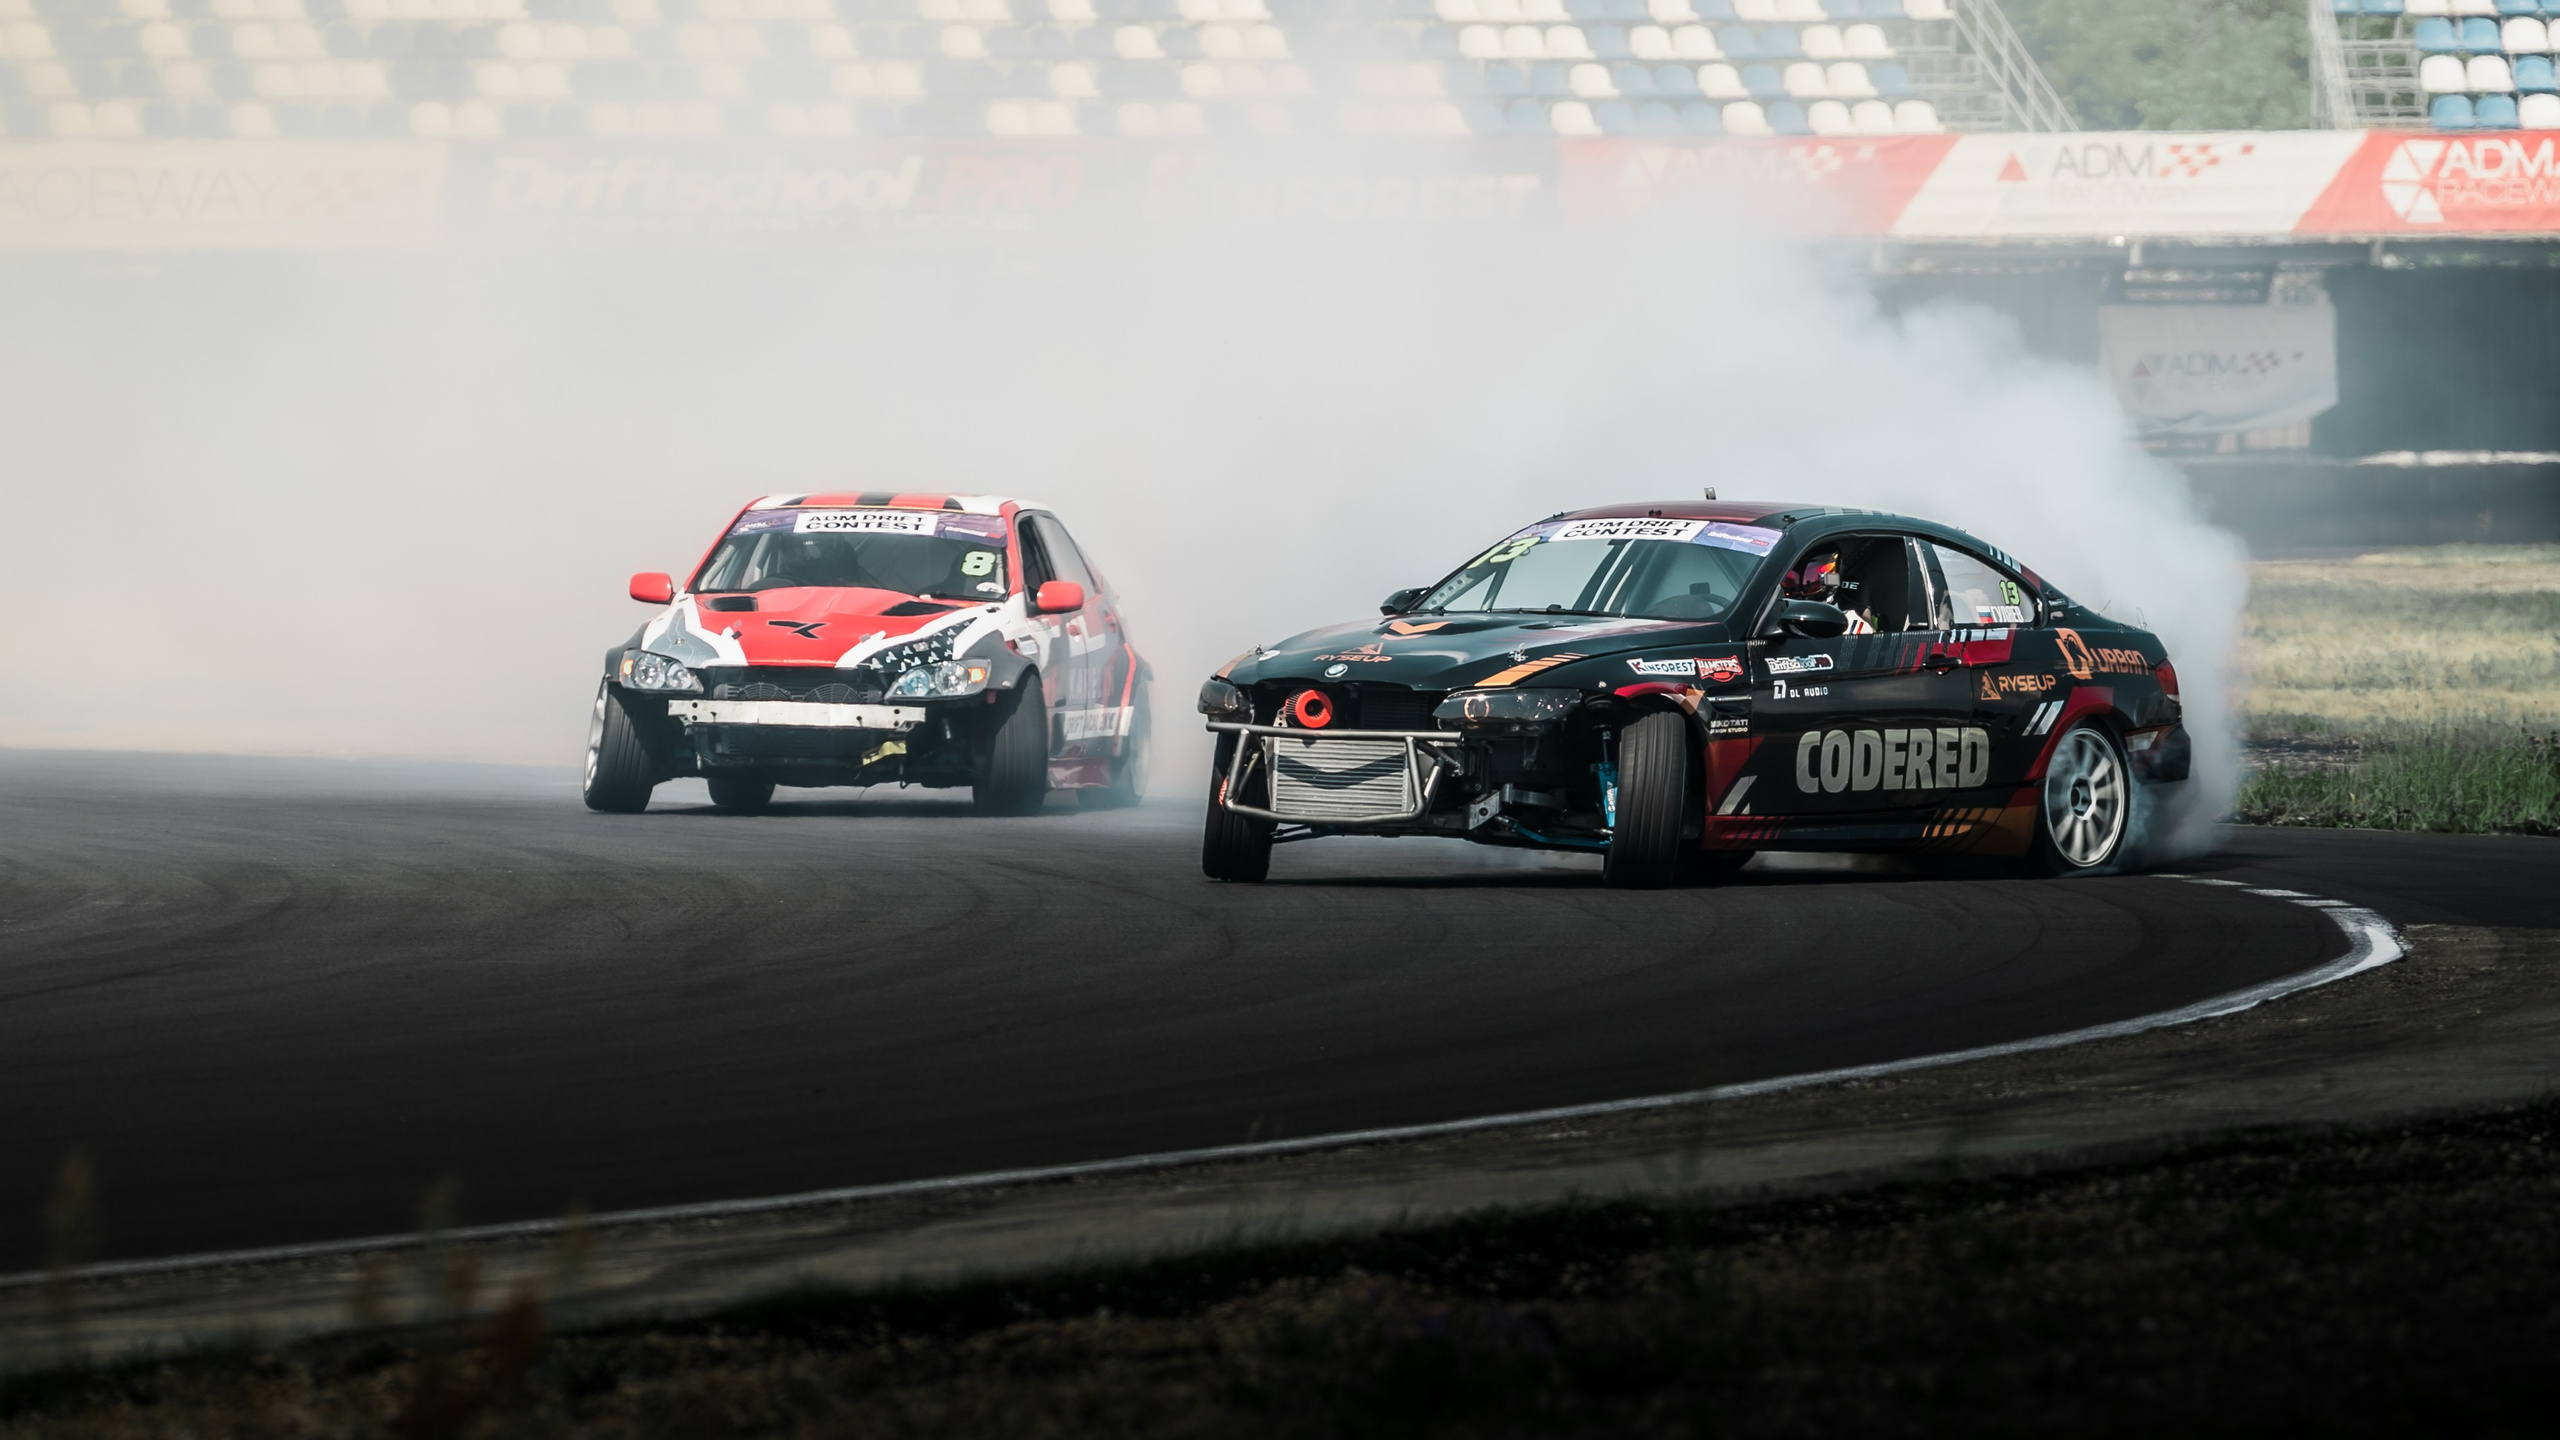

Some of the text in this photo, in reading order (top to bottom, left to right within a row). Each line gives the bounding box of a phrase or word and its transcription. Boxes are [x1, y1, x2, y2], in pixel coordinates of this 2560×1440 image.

[2050, 143, 2155, 179] ADM
[2438, 139, 2554, 178] ADM
[2167, 351, 2239, 376] ADM
[806, 522, 925, 531] CONTEST
[863, 514, 927, 522] DRIFT
[1572, 520, 1697, 529] ADM DRIFT
[1563, 528, 1689, 538] CONTEST
[1467, 536, 1543, 570] 13
[961, 550, 996, 577] 8
[1999, 580, 2021, 606] 13
[1312, 654, 1393, 663] RYSEUP
[1631, 660, 1694, 673] KINFOREST
[1697, 658, 1741, 677] HAMSTERS
[1789, 686, 1829, 699] DL AUDIO
[1998, 674, 2057, 693] RYSEUP
[1796, 727, 1990, 794] CODERED
